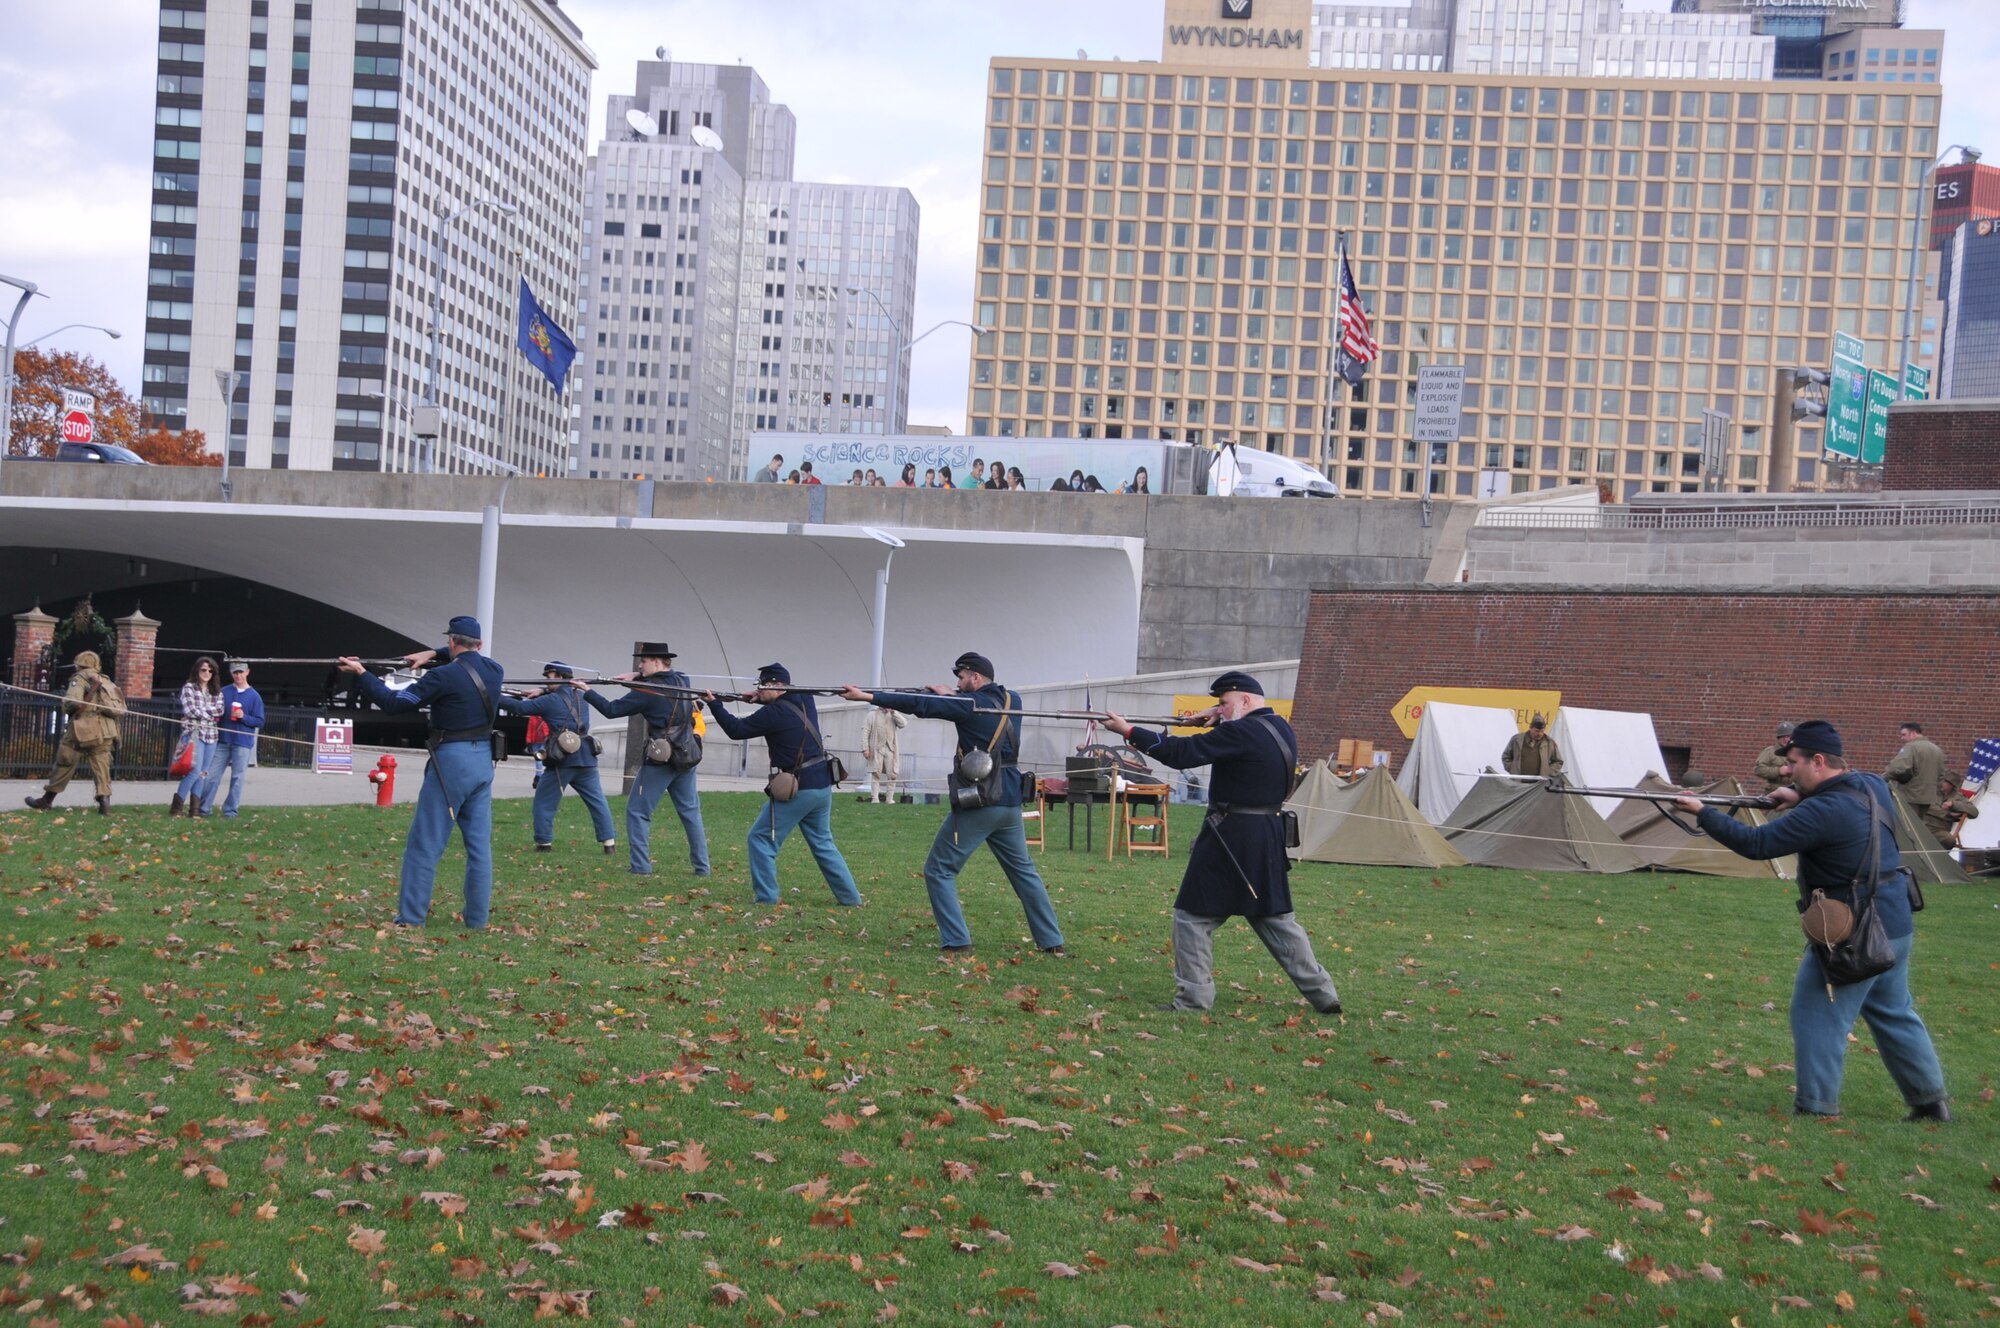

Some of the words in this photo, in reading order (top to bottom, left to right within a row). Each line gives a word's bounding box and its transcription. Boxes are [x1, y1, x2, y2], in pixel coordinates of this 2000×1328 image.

[1169, 25, 1303, 49] WYNDHAM
[1934, 181, 1959, 199] ES
[1849, 341, 1862, 358] 70C
[1421, 370, 1462, 378] FLAMMABLE
[1421, 382, 1443, 390] LIQUID
[1446, 382, 1460, 390] AND
[1873, 379, 1880, 393] Ft
[67, 393, 93, 409] RAMP
[1421, 394, 1458, 402] EXPLOSIVE
[1427, 405, 1449, 413] LOADS
[1841, 403, 1859, 423] North
[64, 420, 91, 438] STOP
[1417, 417, 1457, 425] PROHIBITED
[1838, 424, 1858, 444] Shore
[893, 443, 974, 467] ROCKS!
